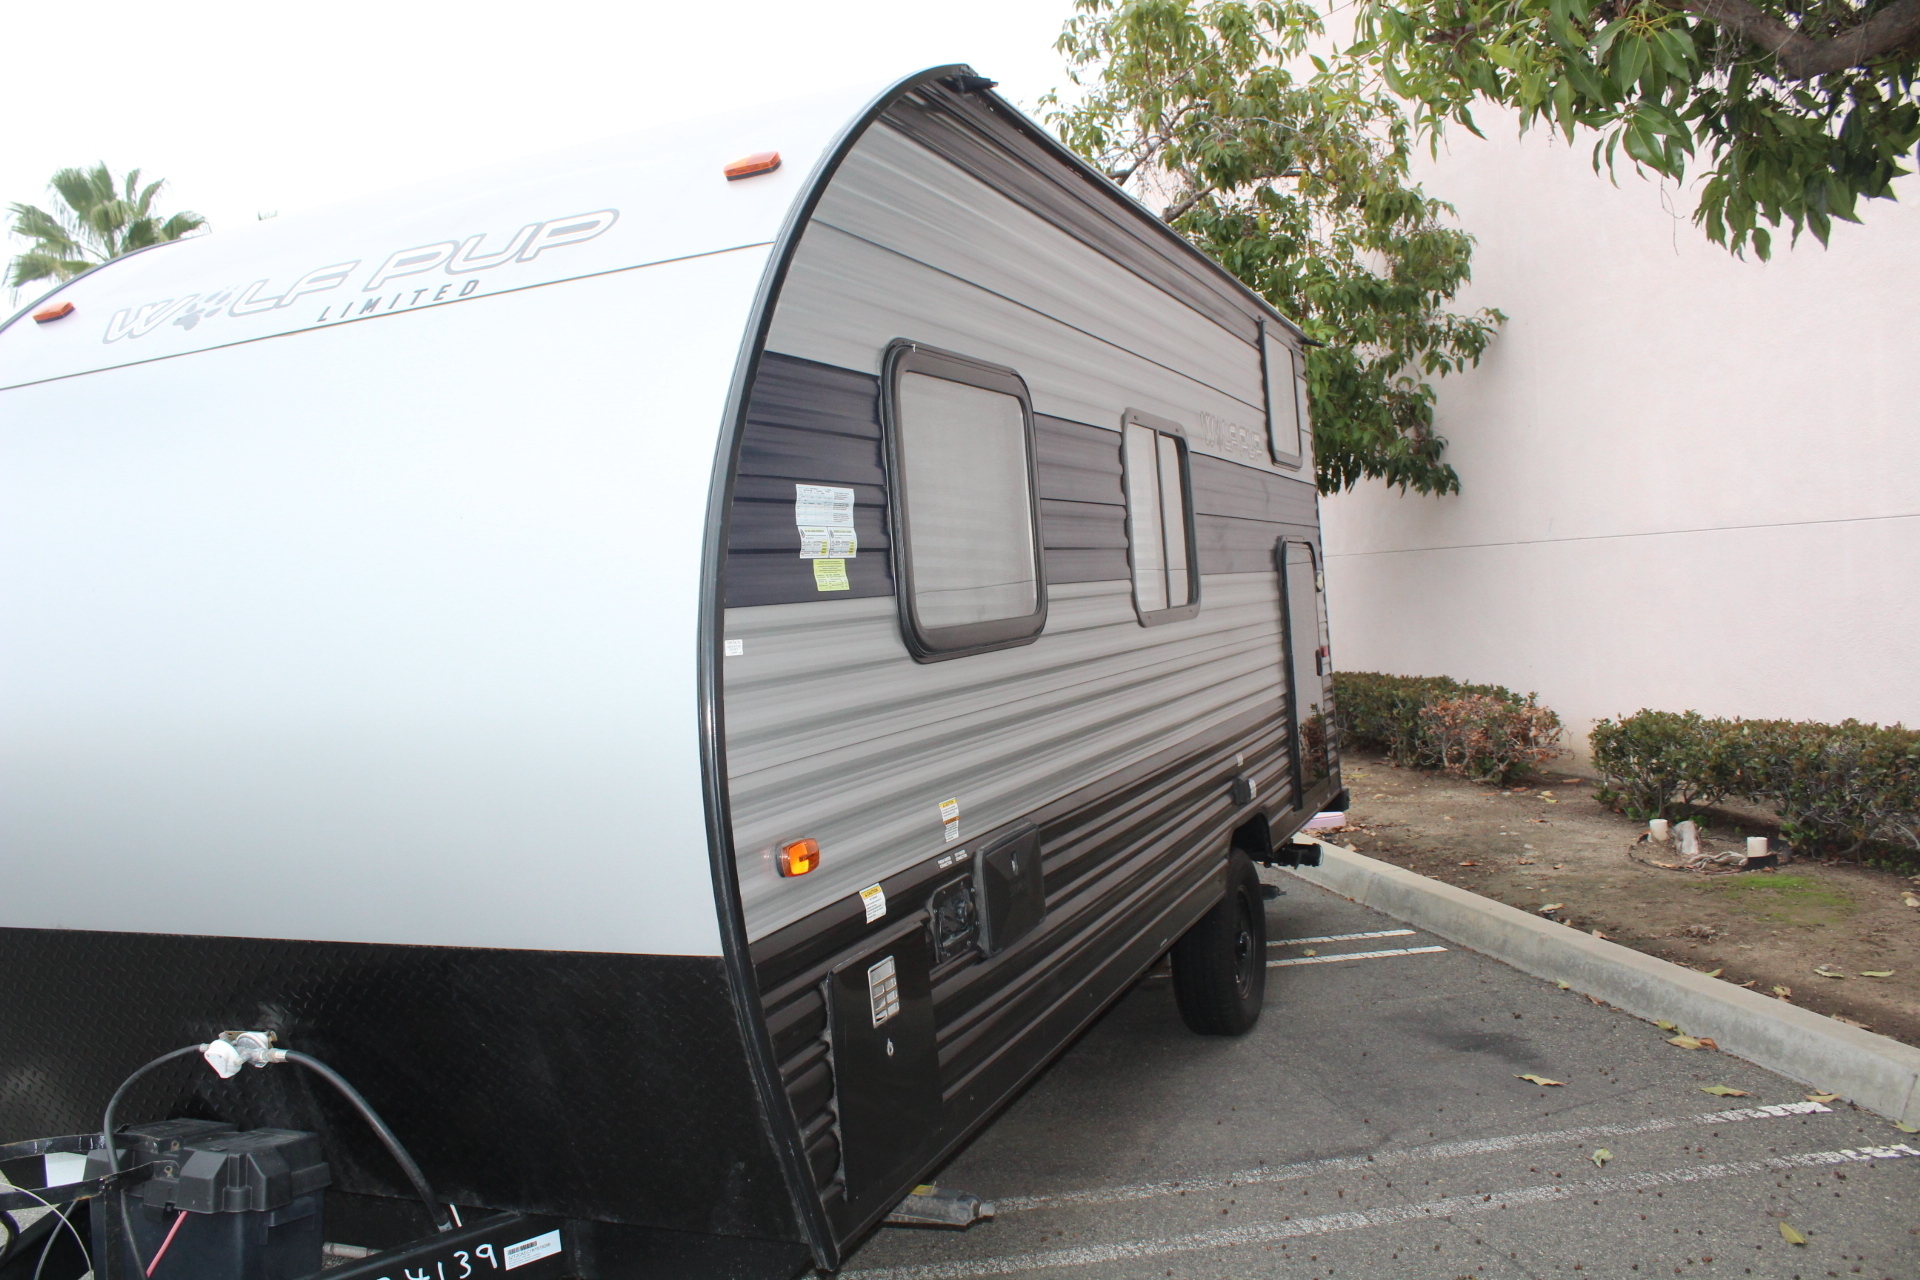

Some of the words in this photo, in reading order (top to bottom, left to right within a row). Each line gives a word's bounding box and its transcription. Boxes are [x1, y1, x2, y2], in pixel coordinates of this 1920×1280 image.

[102, 260, 362, 344] WLF
[362, 208, 620, 292] PUP
[317, 279, 480, 322] LIMITED
[376, 1243, 498, 1280] 4139
